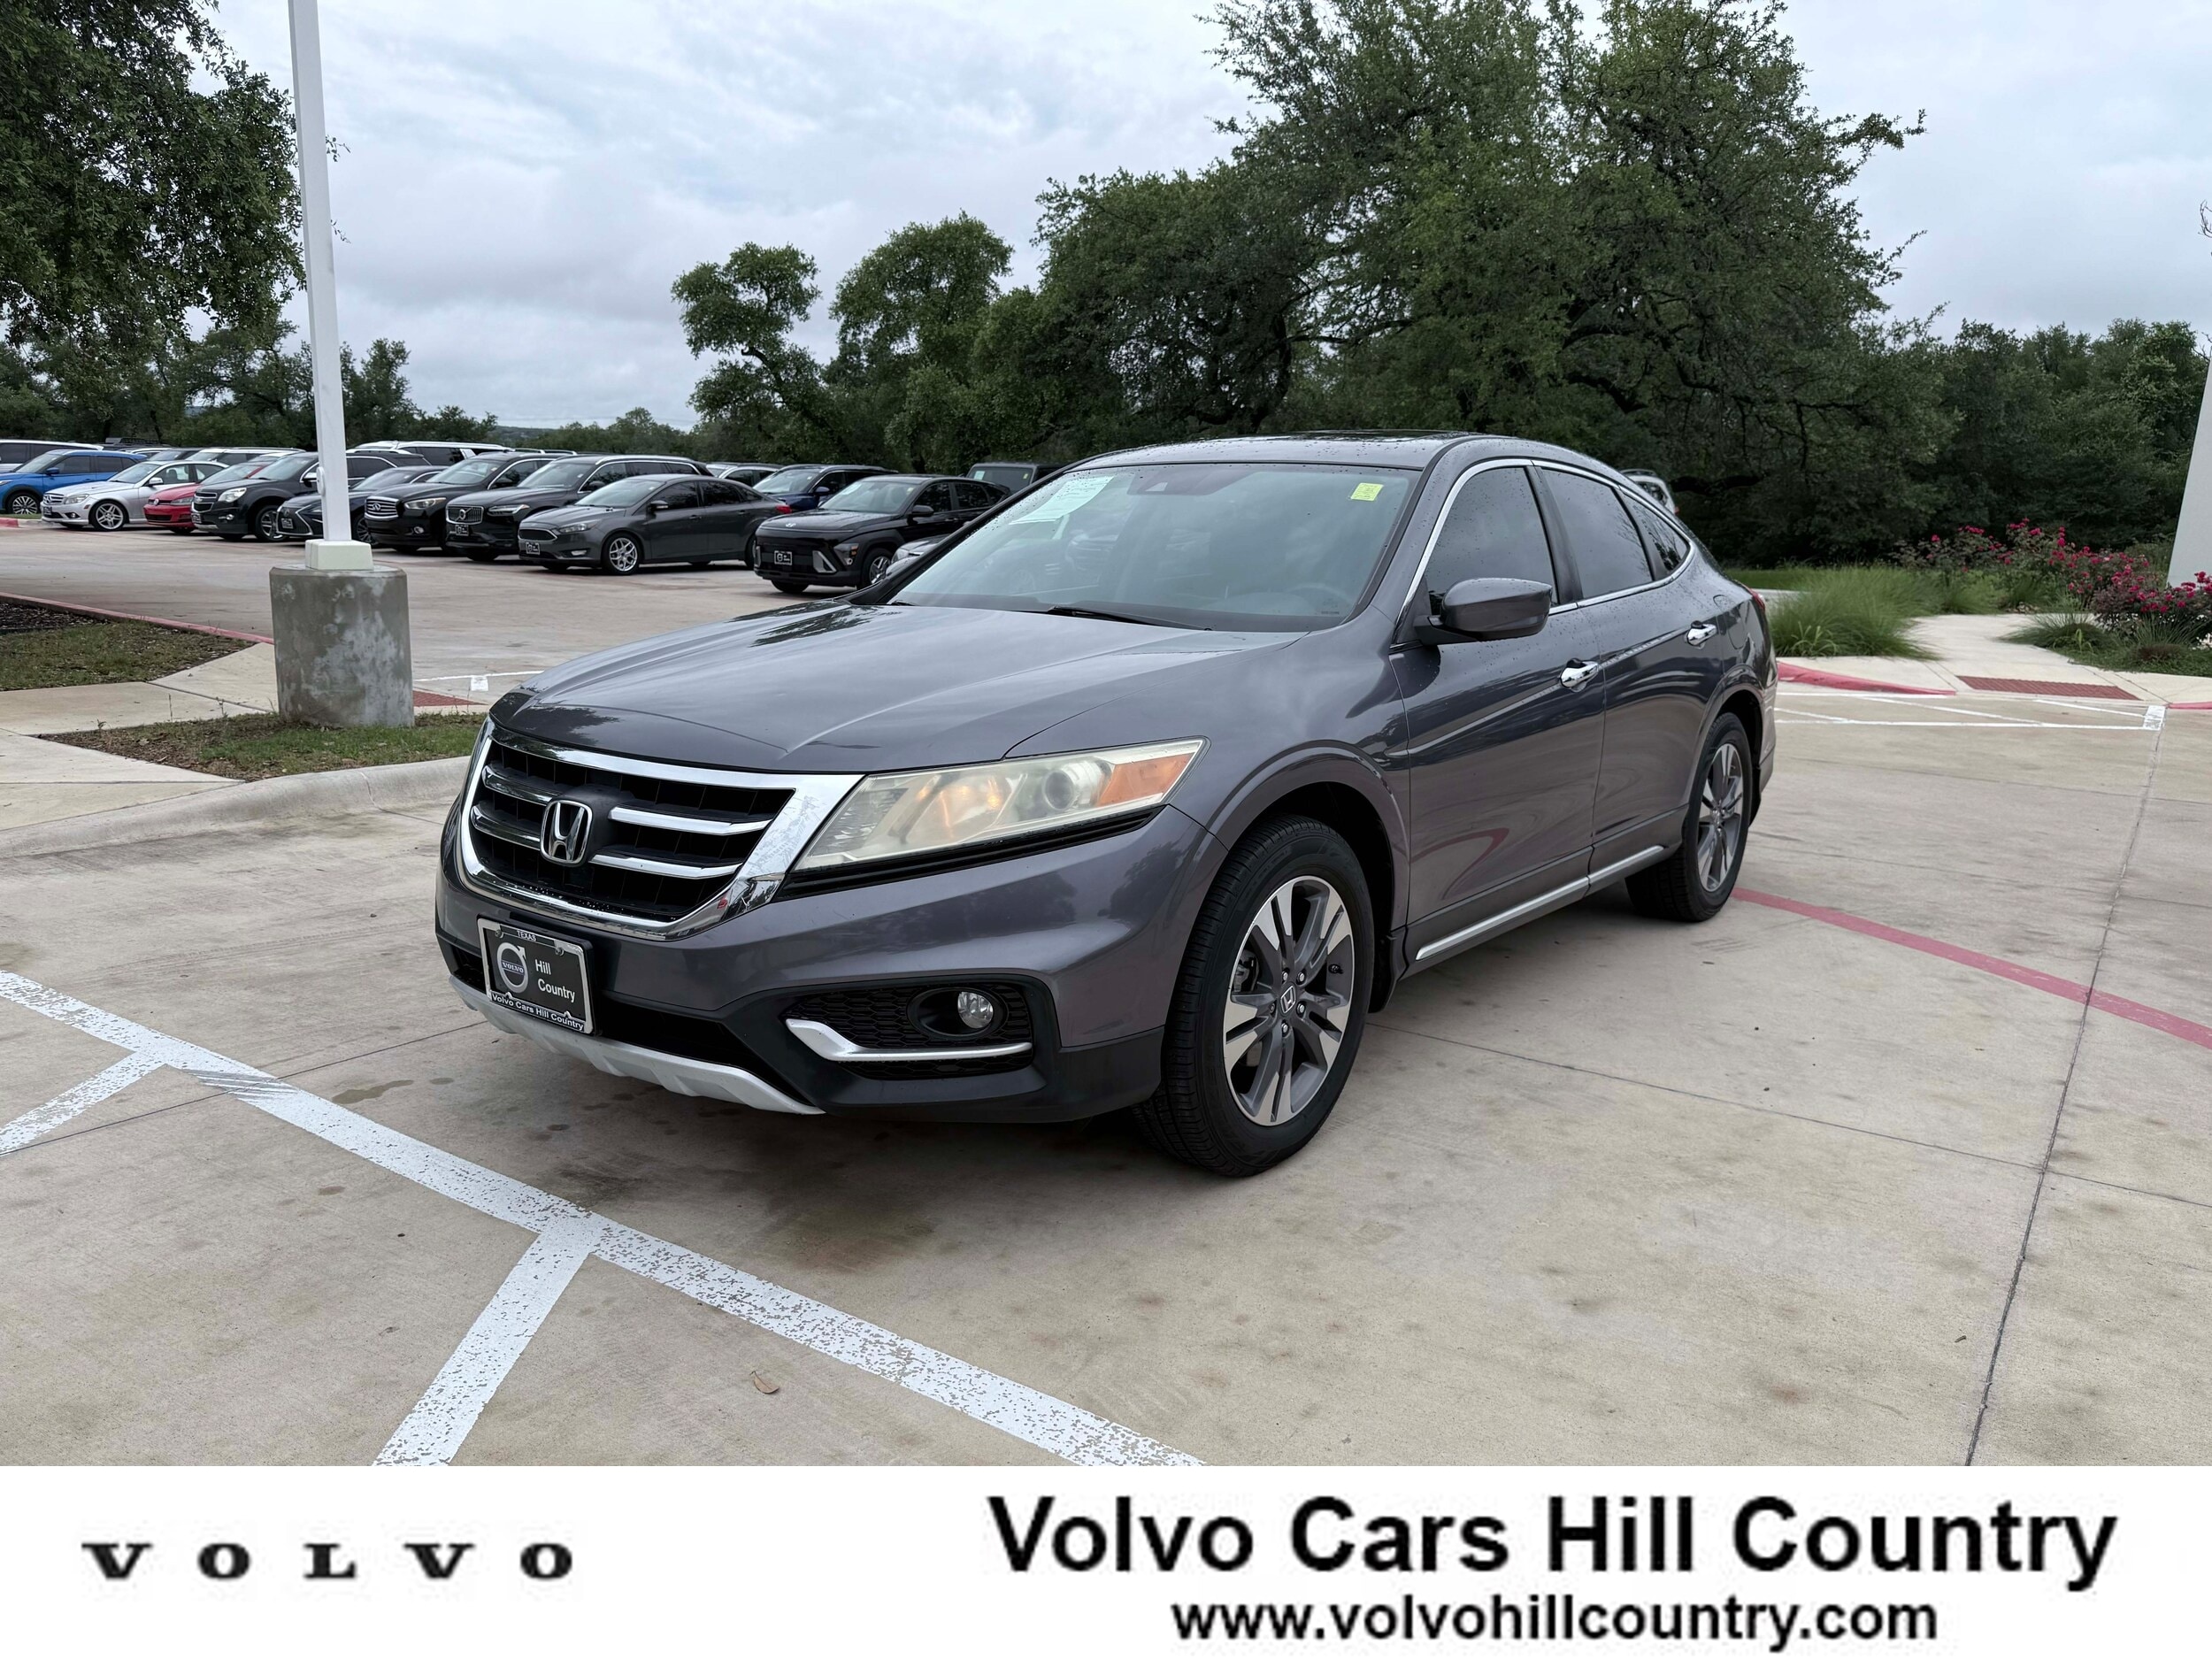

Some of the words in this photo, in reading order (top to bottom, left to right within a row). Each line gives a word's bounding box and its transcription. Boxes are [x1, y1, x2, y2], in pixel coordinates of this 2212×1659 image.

[517, 930, 536, 942] TEXAS
[502, 962, 524, 973] VOLVO
[535, 959, 551, 975] Hill
[537, 979, 575, 1002] Country
[492, 994, 514, 1006] Volvo
[515, 1002, 534, 1013] Cars
[535, 1008, 549, 1018] Hill
[550, 1013, 584, 1031] Country
